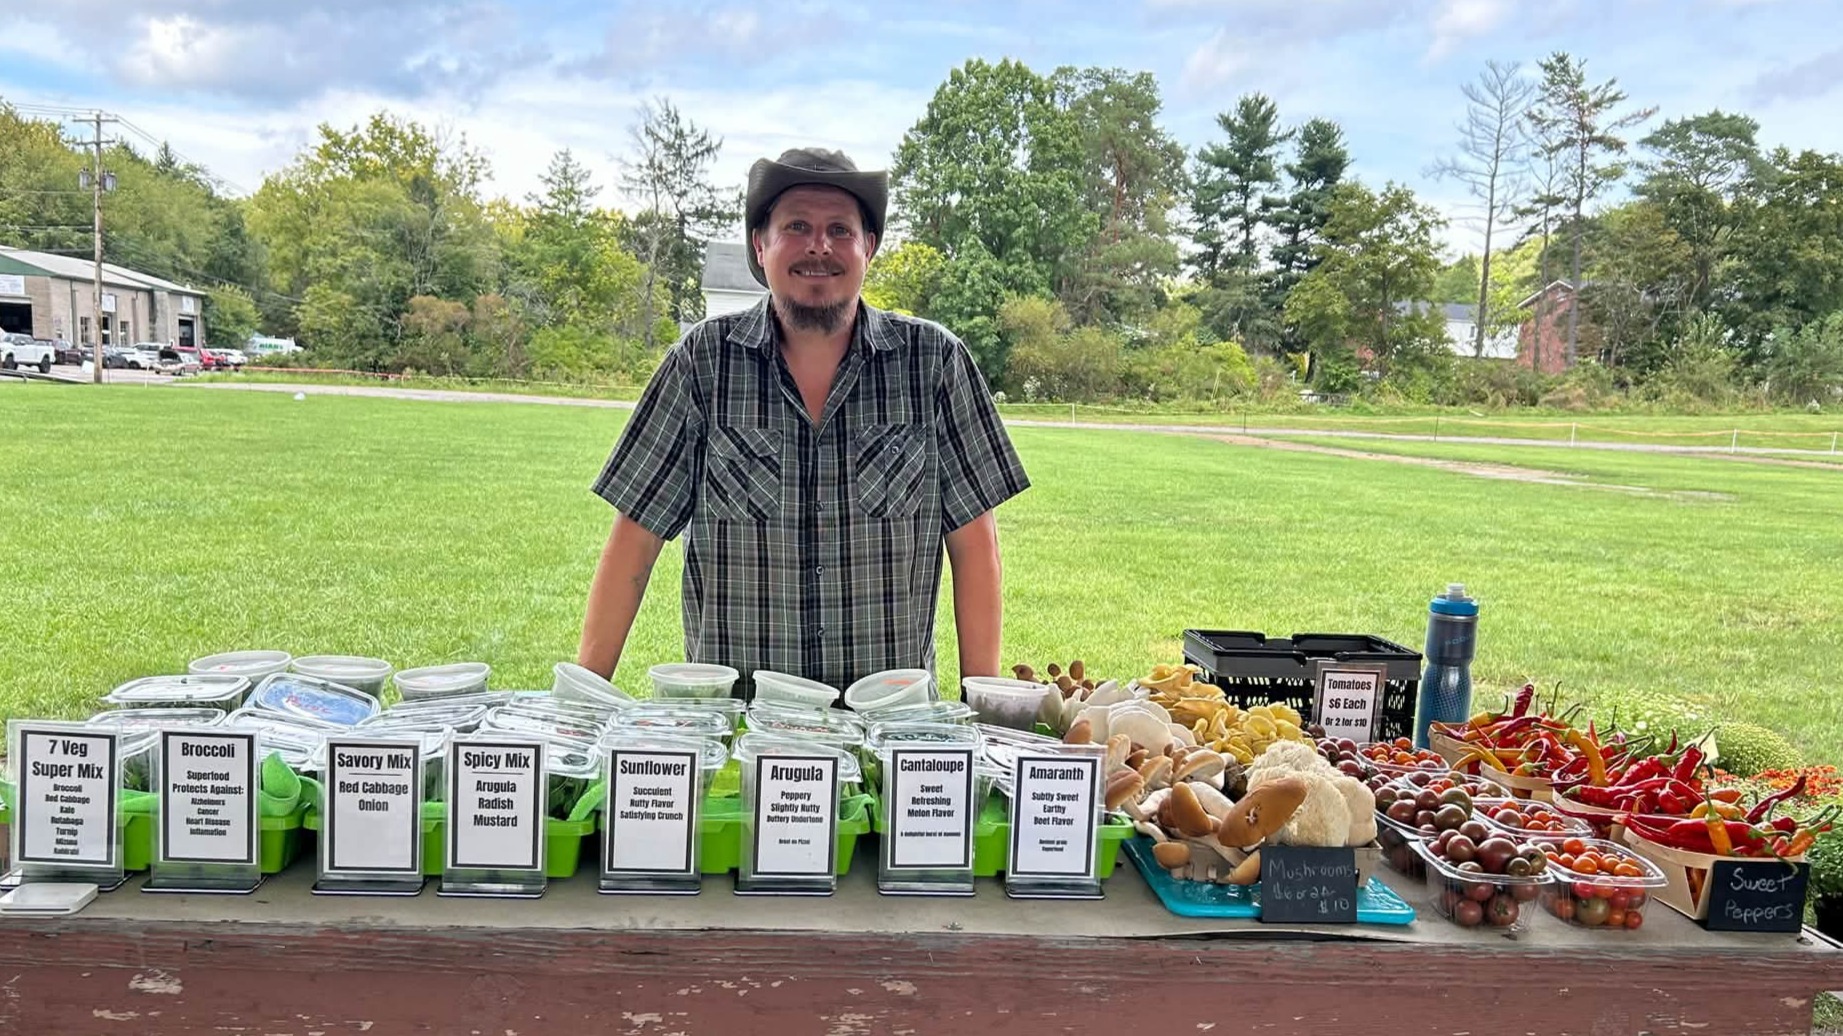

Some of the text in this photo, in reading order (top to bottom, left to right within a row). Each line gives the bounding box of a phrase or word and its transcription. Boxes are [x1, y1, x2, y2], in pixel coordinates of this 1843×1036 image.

[1329, 679, 1371, 690] Tomatoes
[1329, 698, 1366, 709] $6 Each
[1326, 717, 1367, 727] Or 2 for $10
[49, 740, 87, 757] 7 Veg
[182, 743, 234, 757] Broccoli
[338, 753, 411, 770] Savory Mix
[464, 752, 529, 769] Spicy Mix
[33, 761, 103, 779] Super Mix
[621, 760, 686, 775] Sunflower
[901, 759, 964, 773] Cantaloupe
[187, 771, 229, 781] Superfood
[771, 765, 823, 782] Arugula
[1030, 767, 1083, 780] Amaranth
[54, 784, 82, 792] Broccoli
[173, 784, 243, 795] Protects Against:
[339, 781, 408, 795] Red Cabbage
[476, 780, 516, 793] Arugula
[633, 787, 672, 796] Succulent
[921, 785, 942, 793] Sweet
[45, 794, 90, 804] Red Cabbage
[781, 791, 811, 801] Peppery
[1032, 792, 1078, 801] Subtly Sweet
[359, 799, 388, 811] Onion
[479, 798, 513, 809] Radish
[630, 799, 674, 808] Nutty Flavor
[912, 797, 951, 806] Refreshing
[60, 806, 75, 814] Kale
[771, 803, 820, 813] Slightly Nutty
[908, 809, 954, 817] Melon Flavor
[1043, 805, 1066, 814] Earthy
[474, 815, 517, 826] Mustard
[621, 811, 683, 820] Satisfying Crunch
[767, 815, 789, 823] Buttery
[51, 816, 83, 826] Rutabaga
[205, 818, 230, 826] Disease
[1034, 817, 1073, 825] Beet Flavor
[56, 827, 78, 837] Turnip
[1269, 859, 1353, 880] Mushrooms
[1730, 867, 1790, 891] Sweet
[1297, 890, 1307, 899] or
[1725, 899, 1793, 923] Peppers
